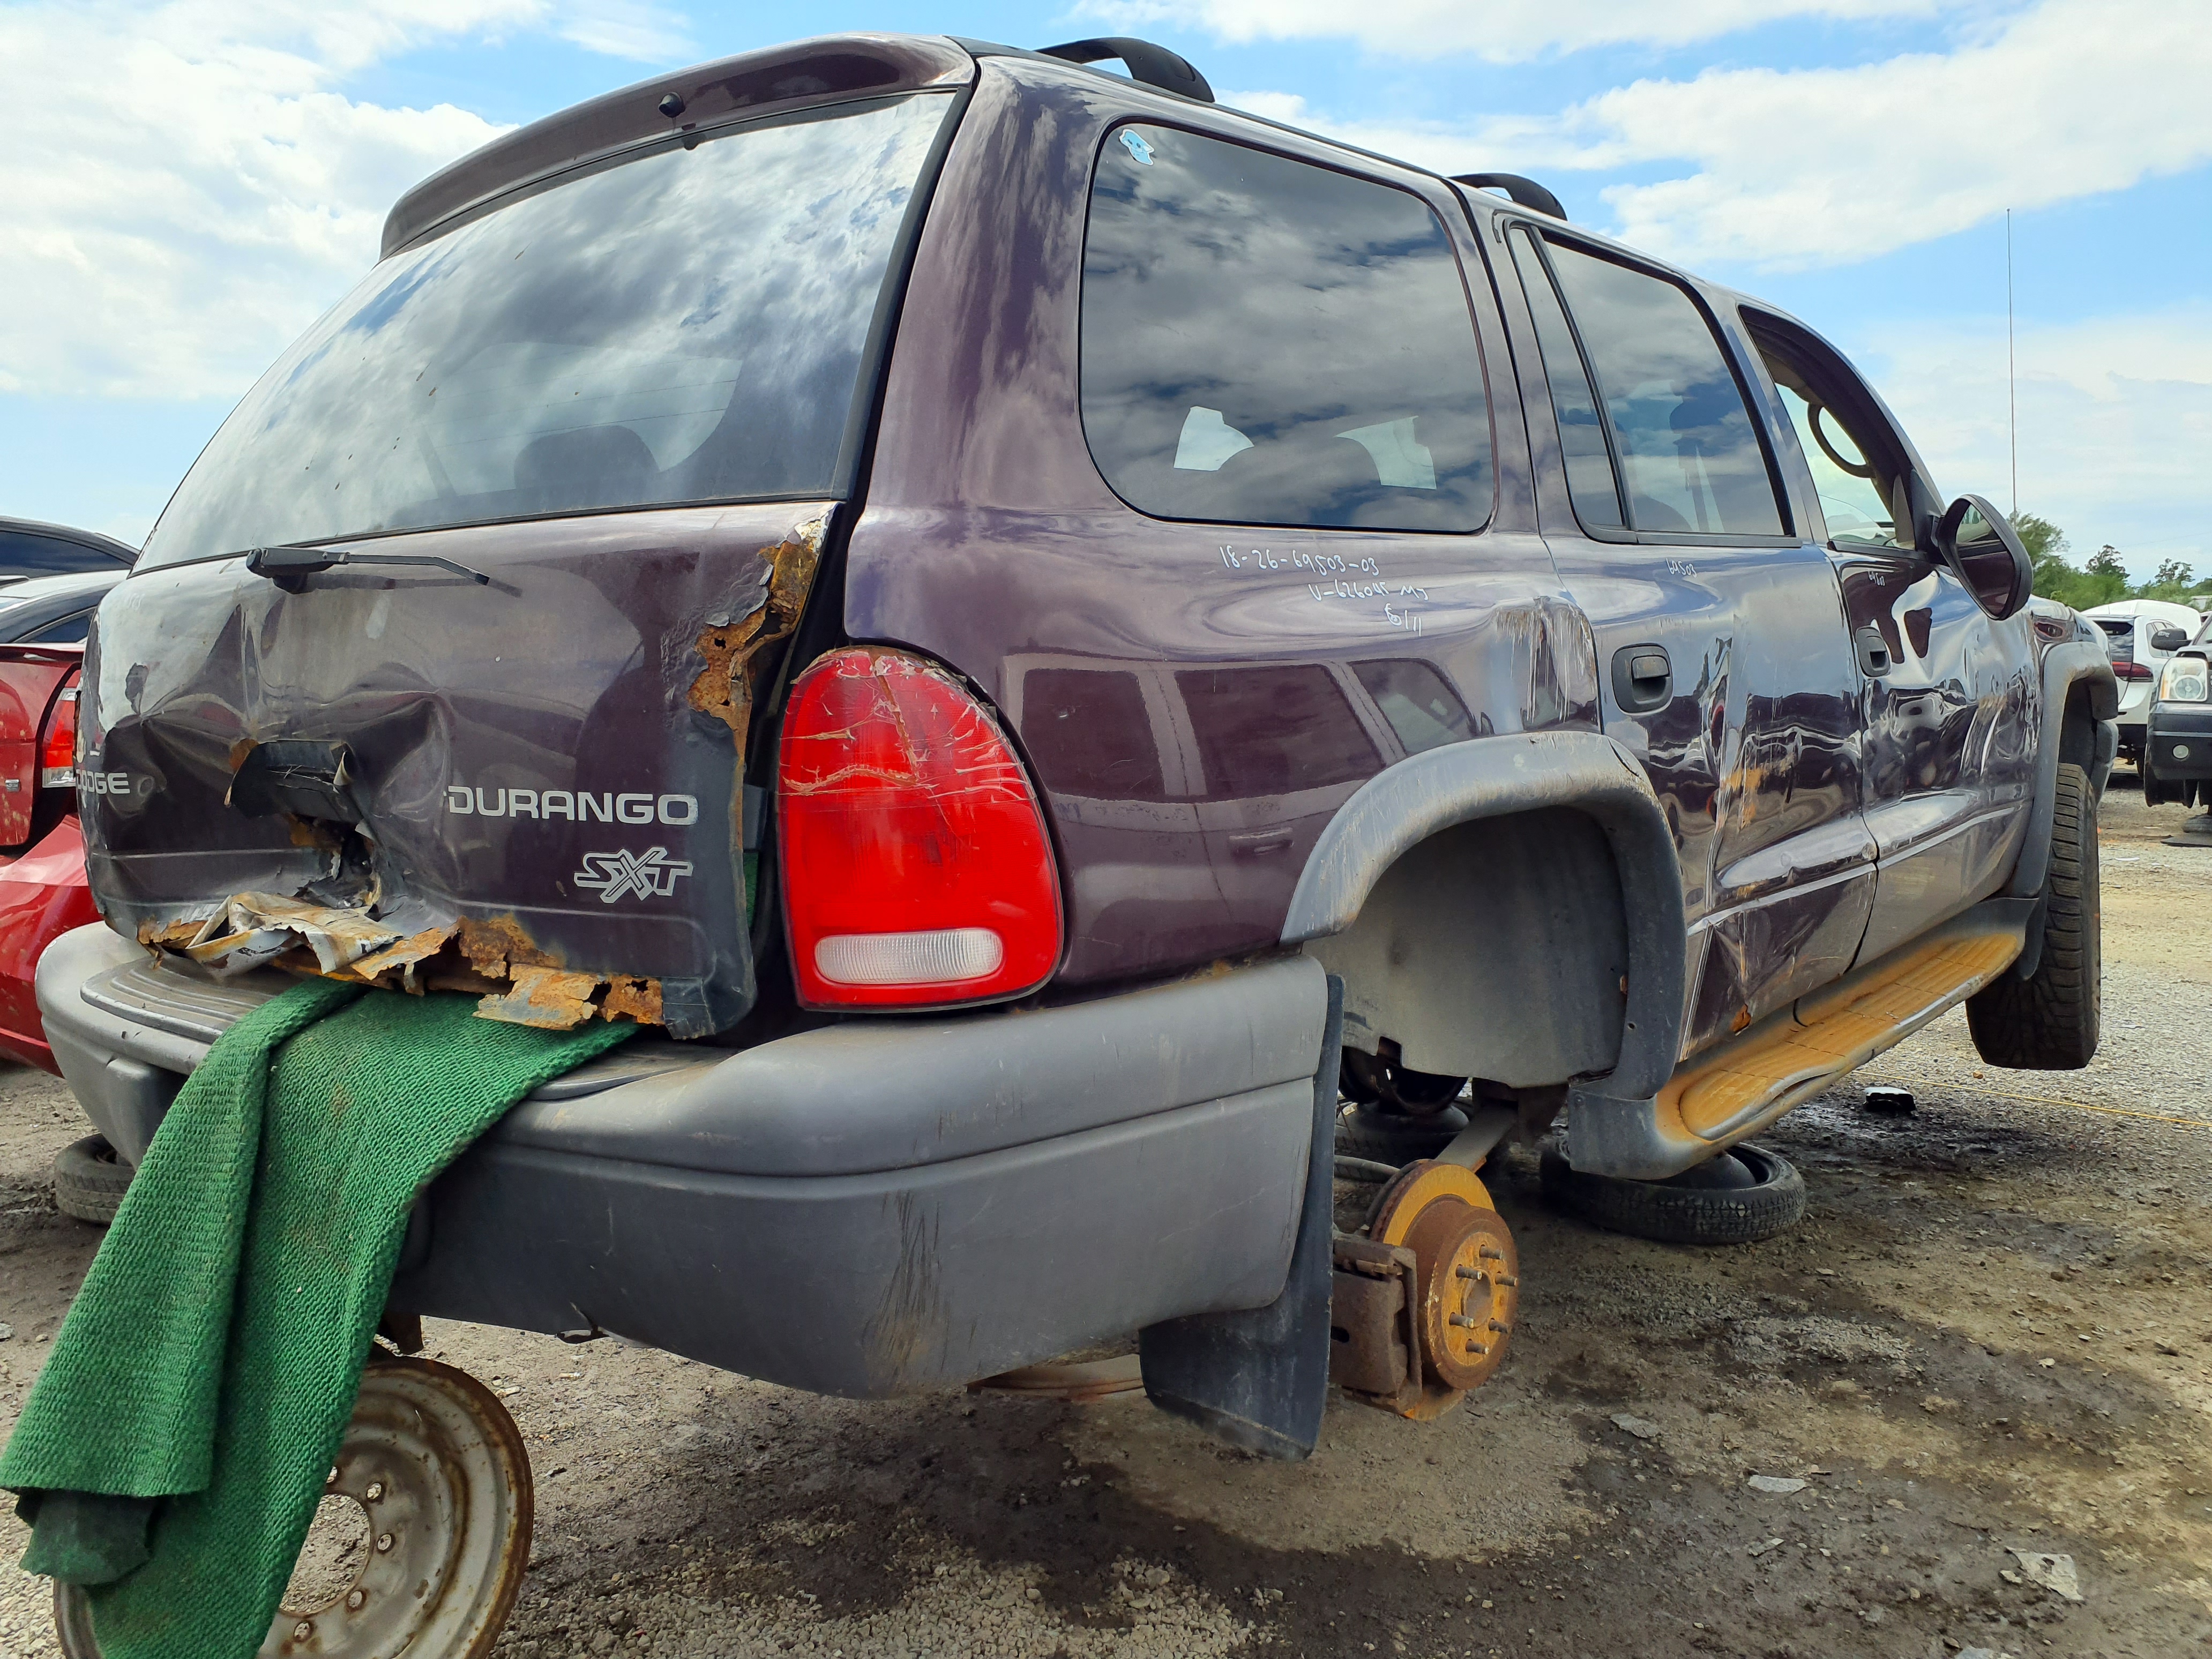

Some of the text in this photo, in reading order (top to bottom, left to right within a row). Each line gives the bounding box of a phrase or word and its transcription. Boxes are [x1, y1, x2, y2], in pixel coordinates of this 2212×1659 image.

[76, 768, 131, 794] DODGE
[448, 785, 699, 826] DURANGO
[573, 846, 694, 904] SXT
